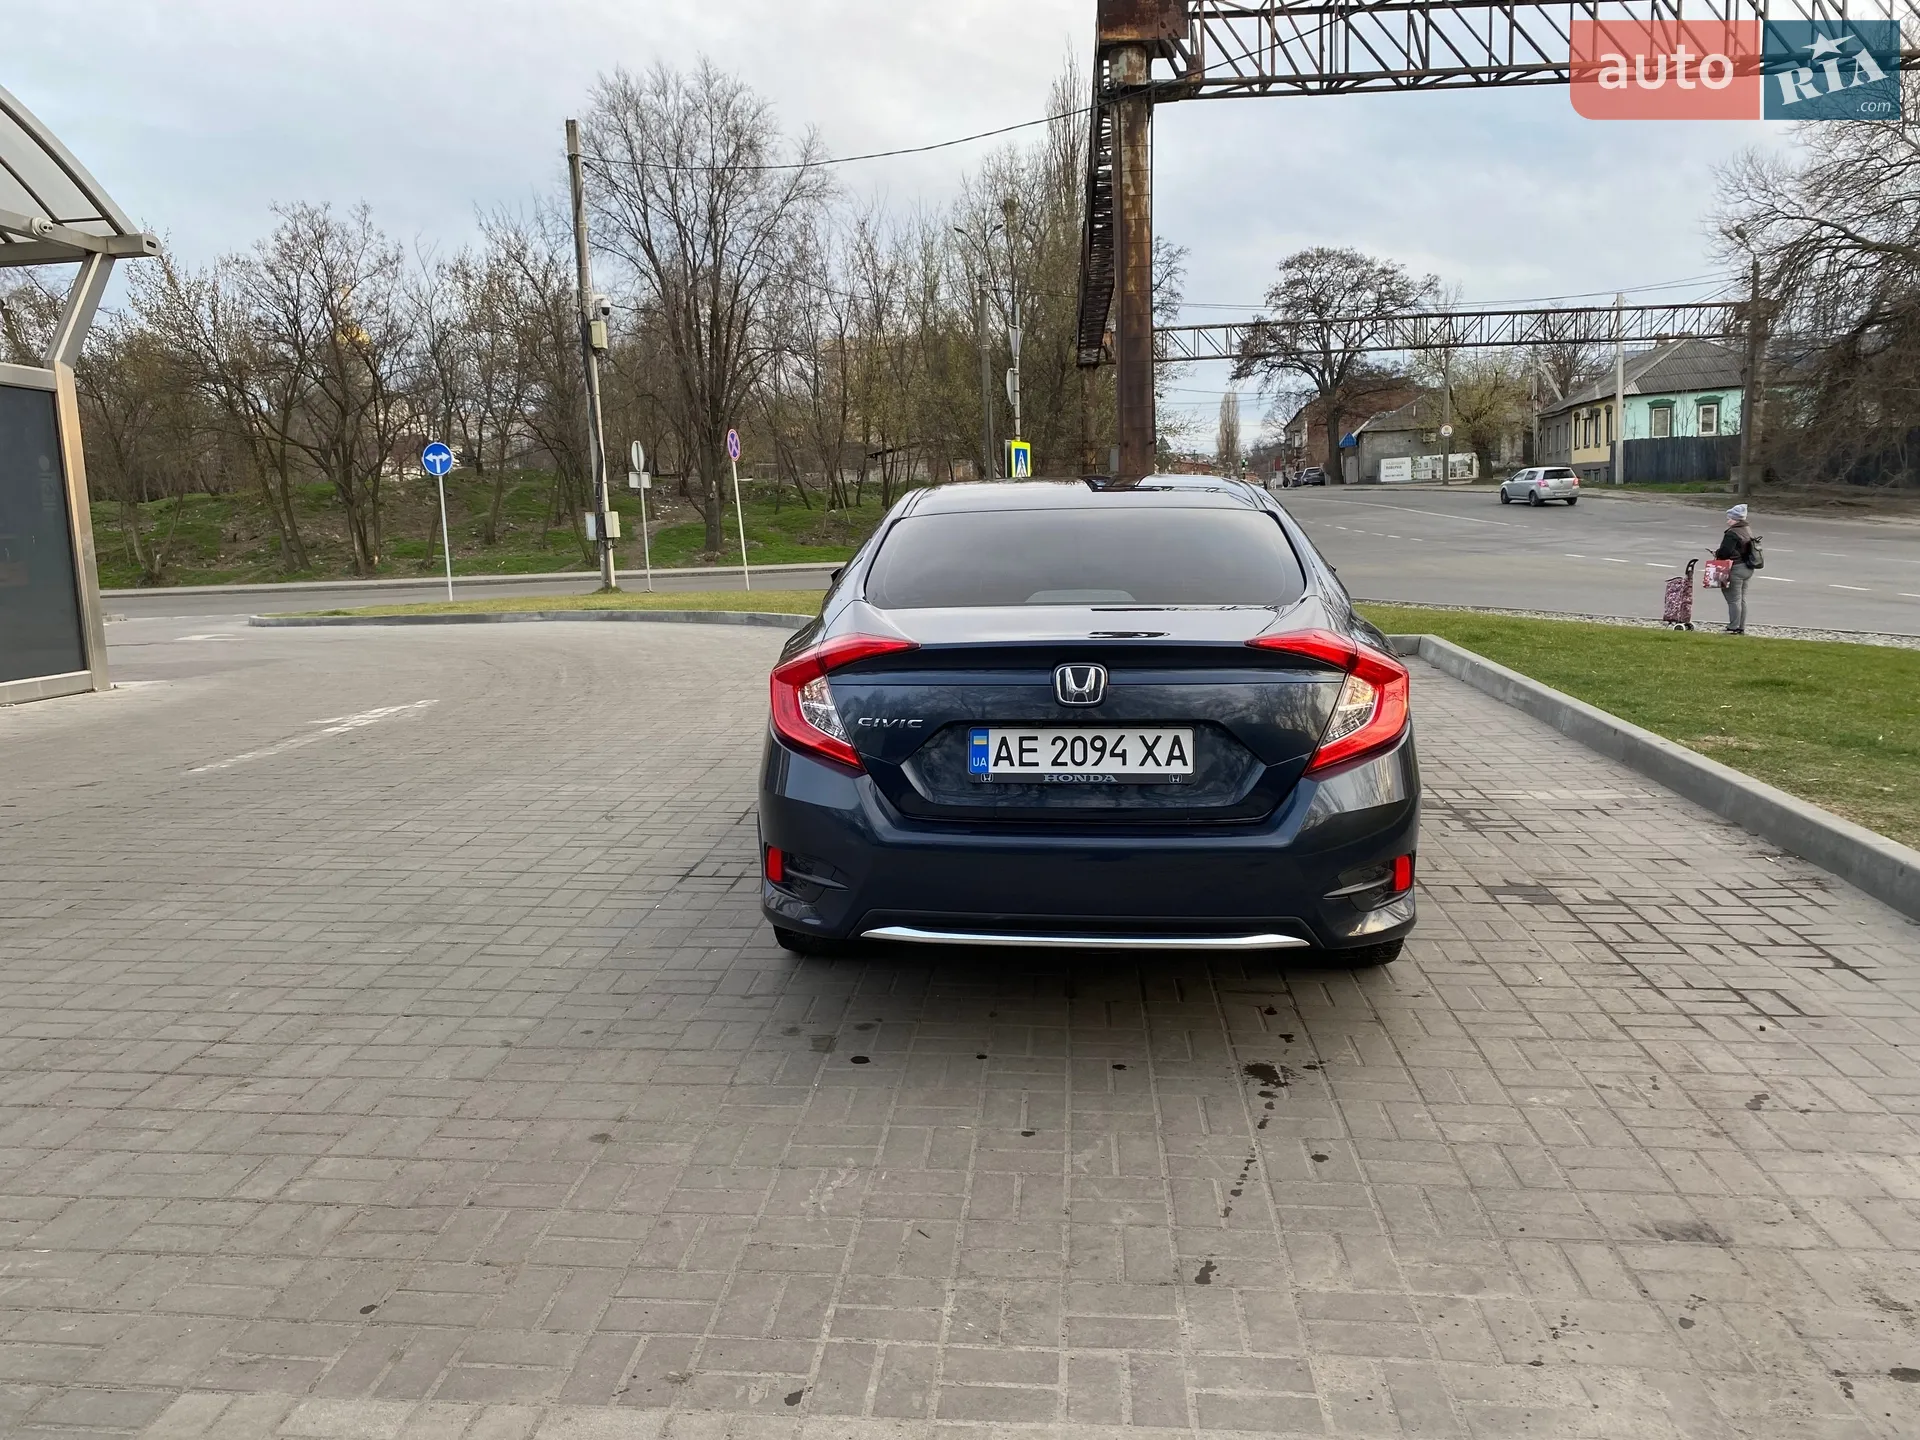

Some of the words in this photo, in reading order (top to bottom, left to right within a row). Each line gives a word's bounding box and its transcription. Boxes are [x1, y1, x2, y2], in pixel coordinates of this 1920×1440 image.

[857, 717, 924, 729] CIVIC
[992, 735, 1040, 767] AE
[1050, 734, 1127, 767] 2094
[1138, 734, 1189, 767] XA
[972, 757, 988, 767] UA
[1043, 773, 1119, 784] HONDA
